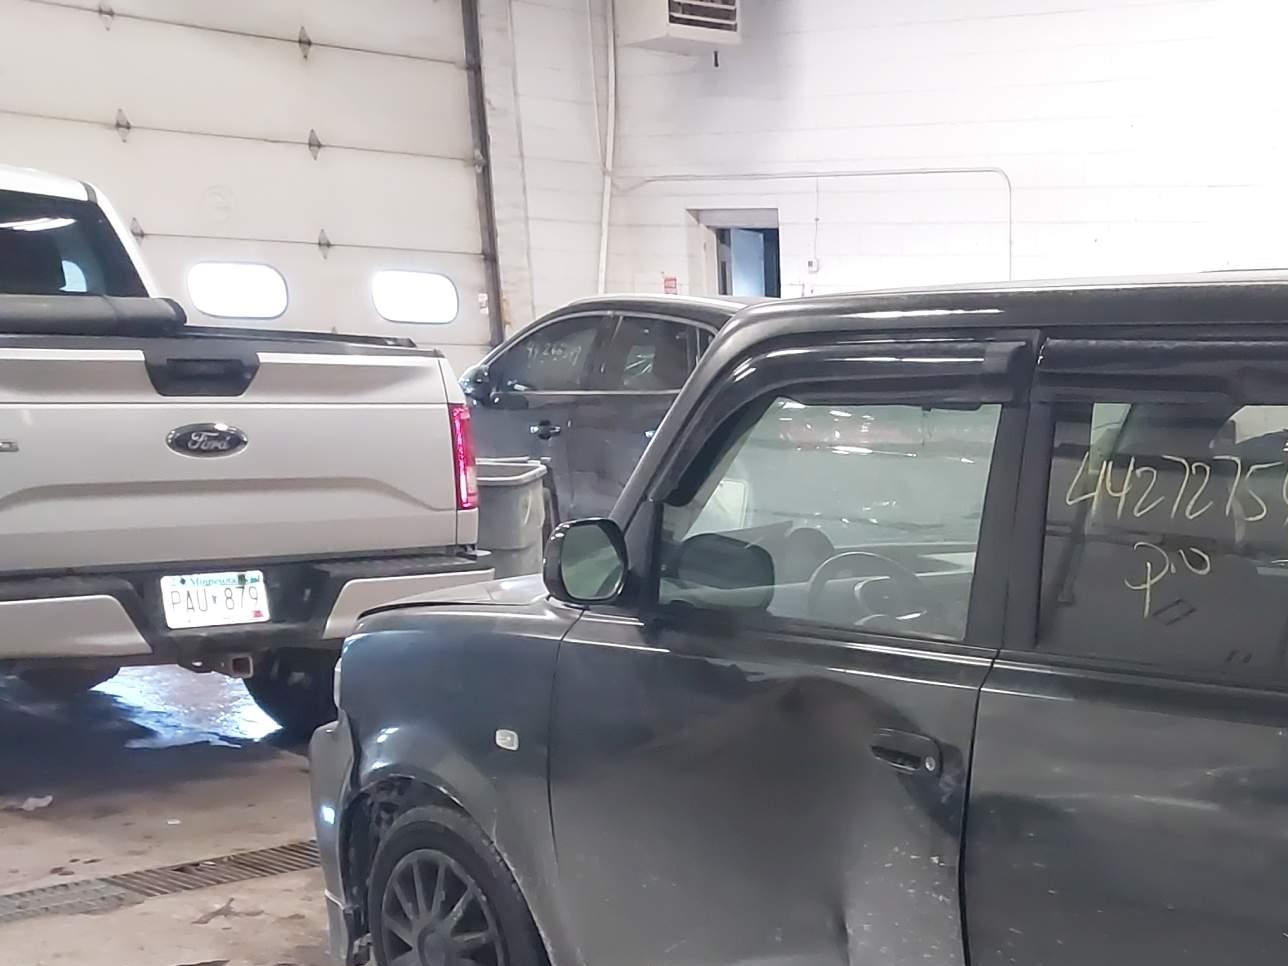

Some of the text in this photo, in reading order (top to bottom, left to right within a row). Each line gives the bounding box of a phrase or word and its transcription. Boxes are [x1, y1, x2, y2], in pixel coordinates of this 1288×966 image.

[187, 430, 231, 453] Ford
[170, 586, 259, 613] PAU 879
